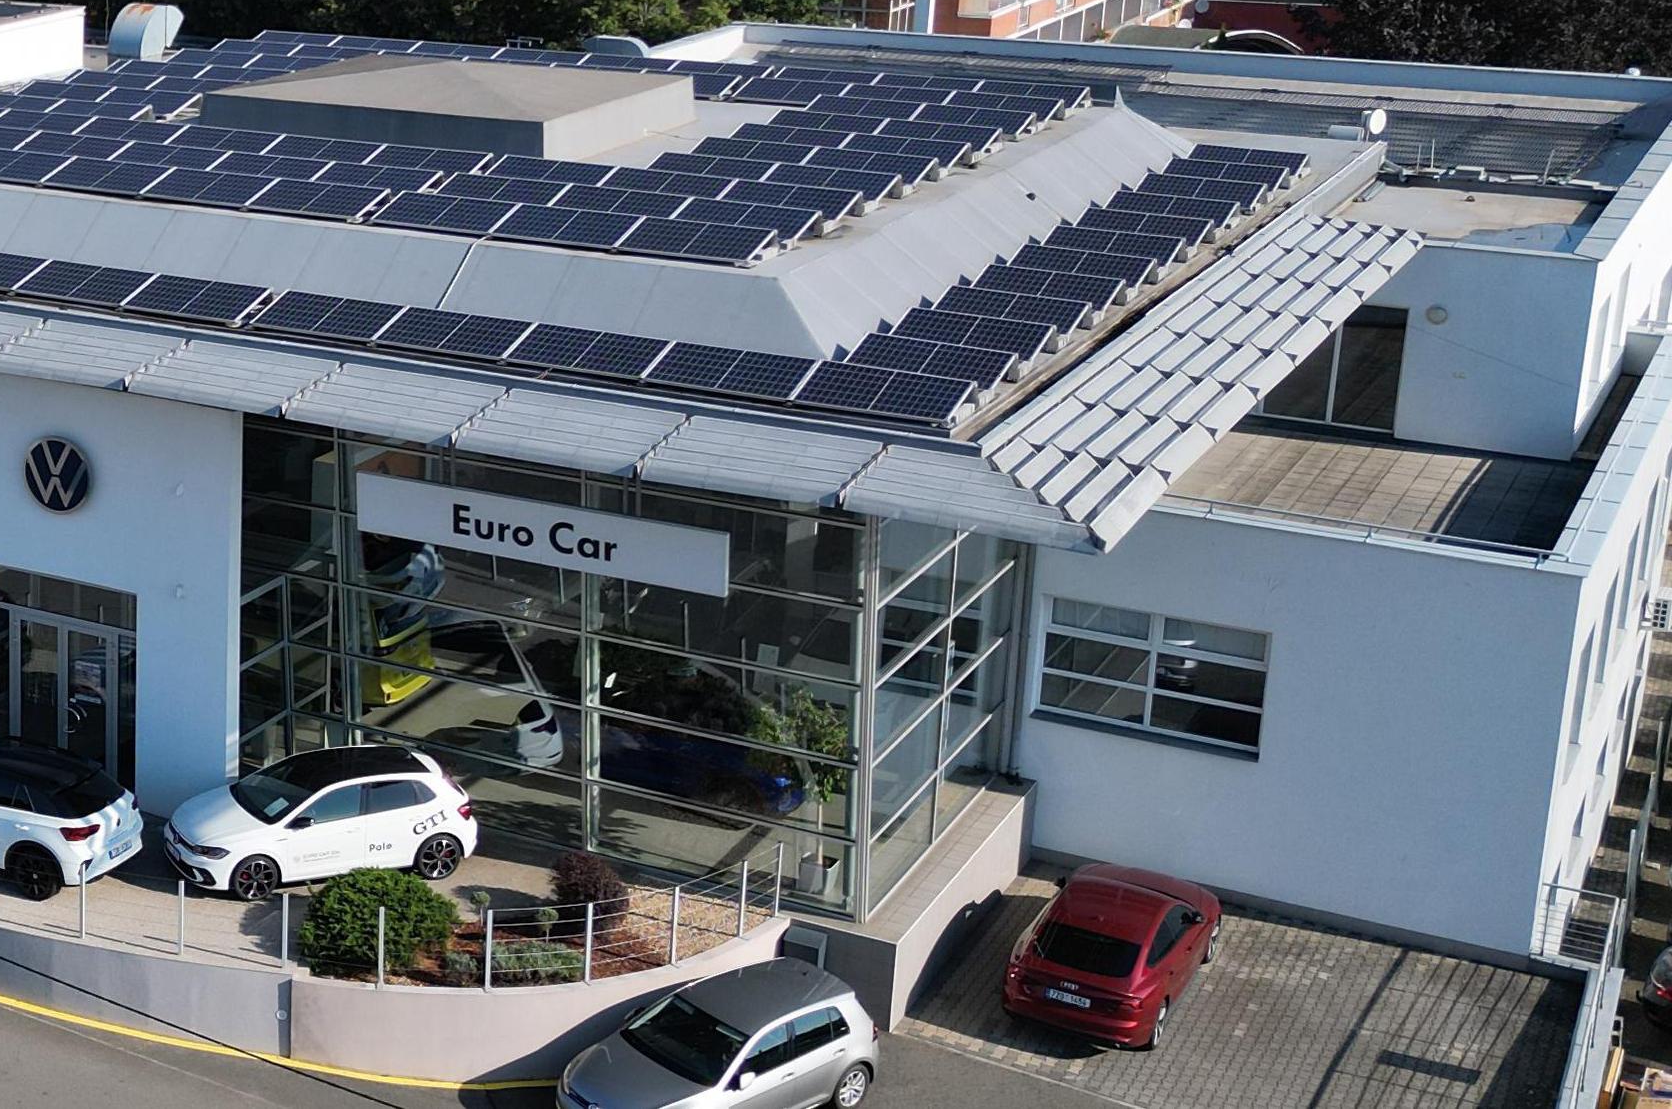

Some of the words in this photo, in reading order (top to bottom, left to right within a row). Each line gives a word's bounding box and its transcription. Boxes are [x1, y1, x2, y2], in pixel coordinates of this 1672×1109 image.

[452, 503, 535, 547] Euro
[548, 521, 618, 562] Car
[412, 809, 449, 836] GTI
[369, 842, 393, 853] Polo
